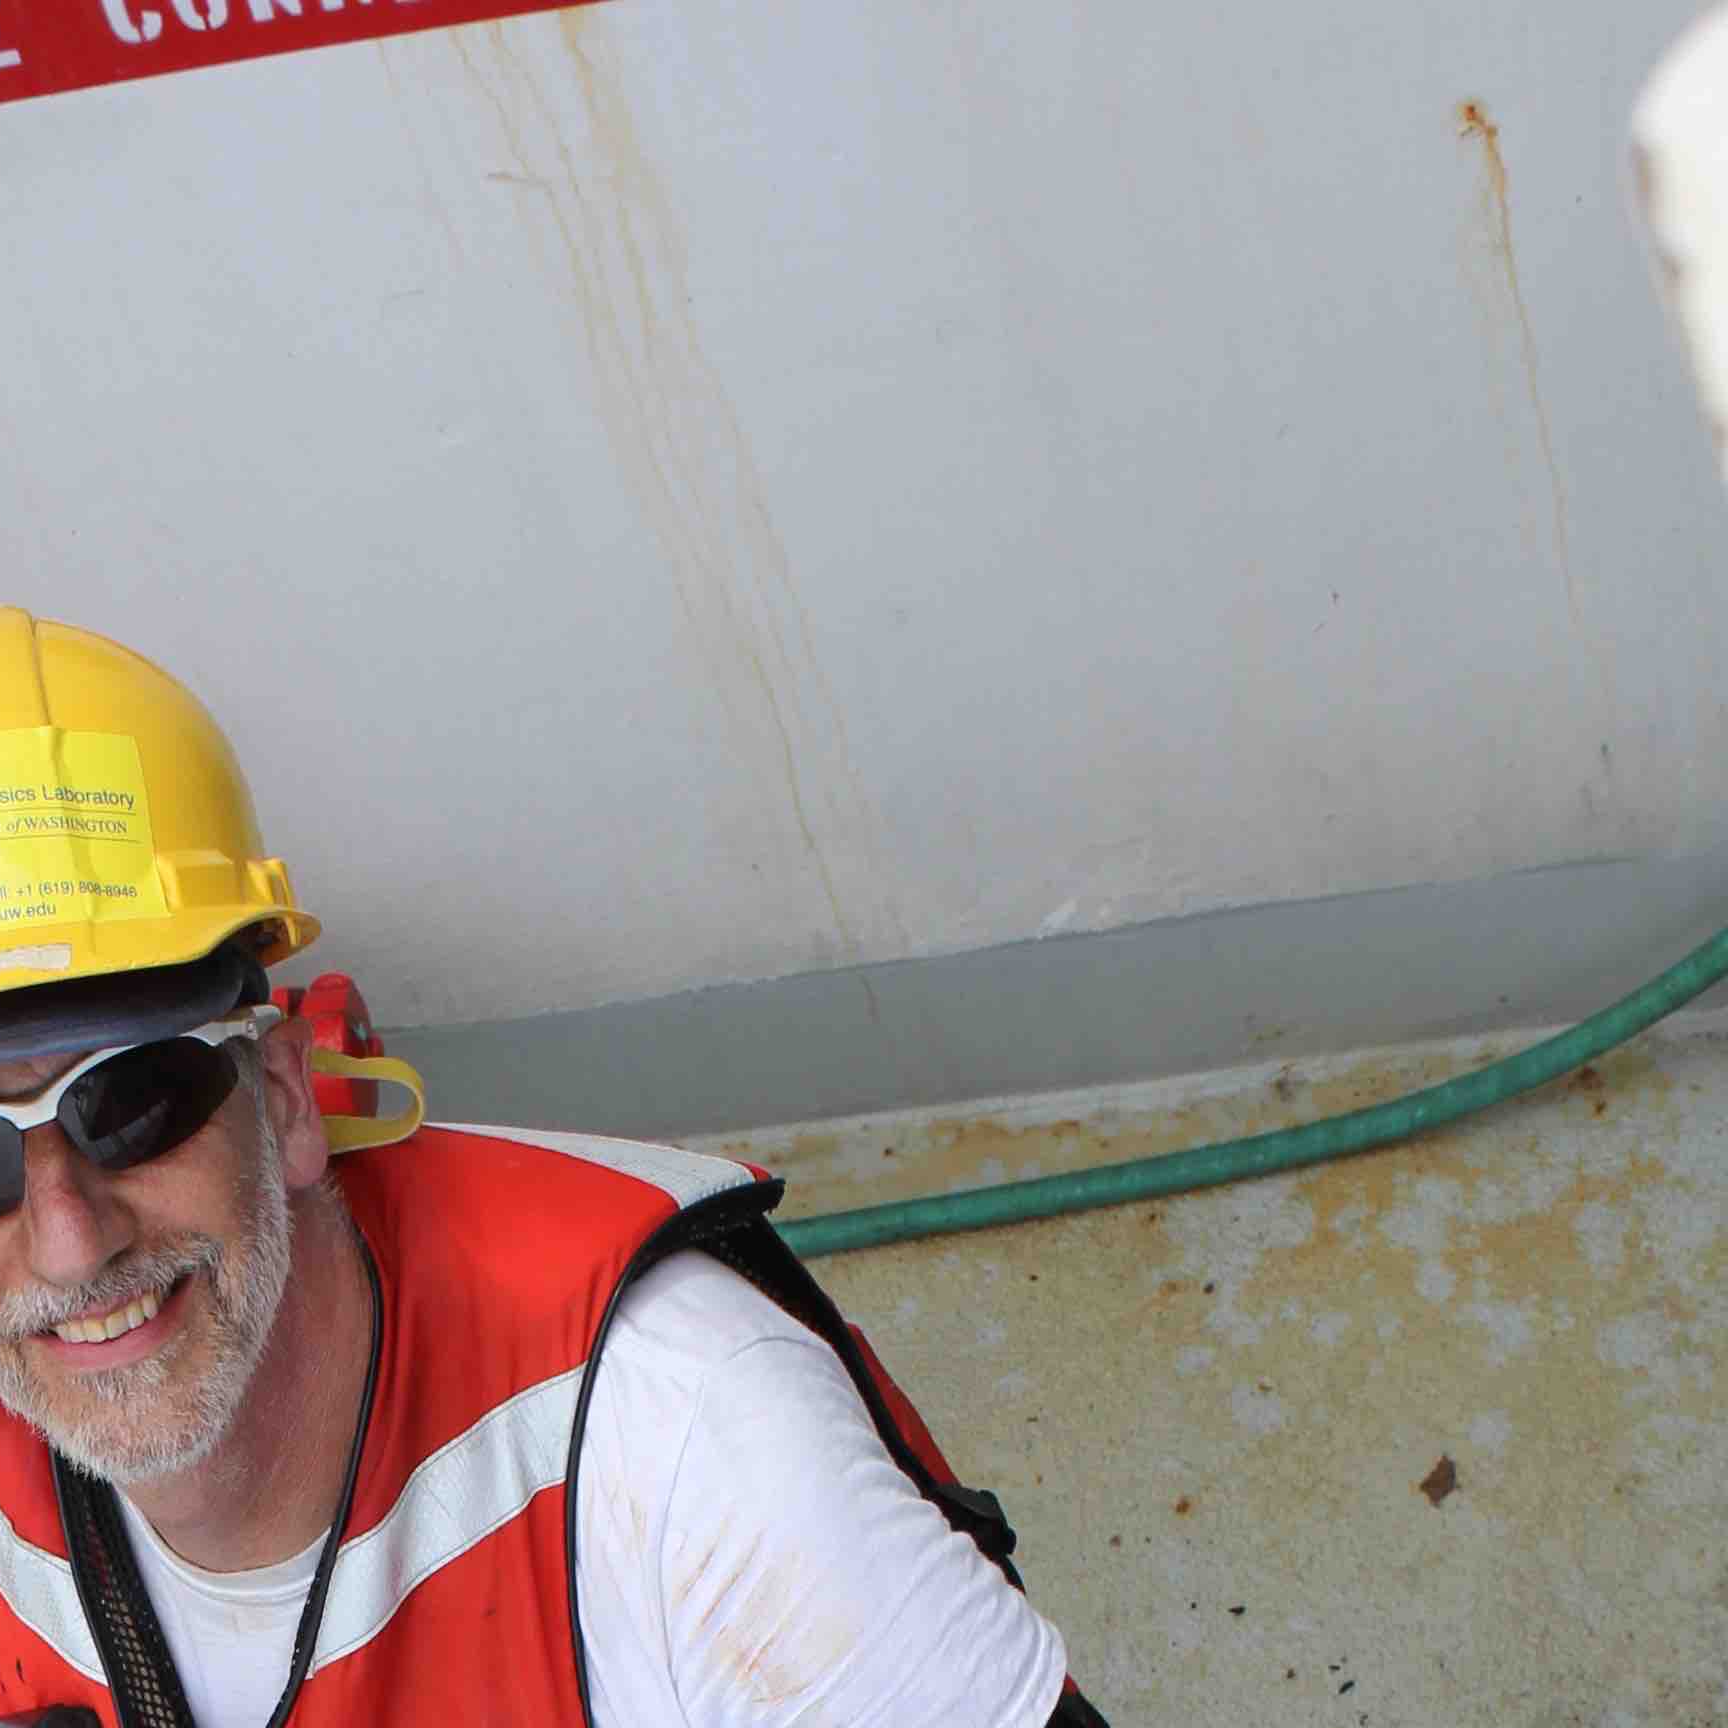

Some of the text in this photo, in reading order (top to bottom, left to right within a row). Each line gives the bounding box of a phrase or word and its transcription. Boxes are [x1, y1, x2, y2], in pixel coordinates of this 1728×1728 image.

[42, 784, 134, 810] Laboratory
[5, 817, 22, 833] of
[23, 815, 128, 834] WASHINGTON
